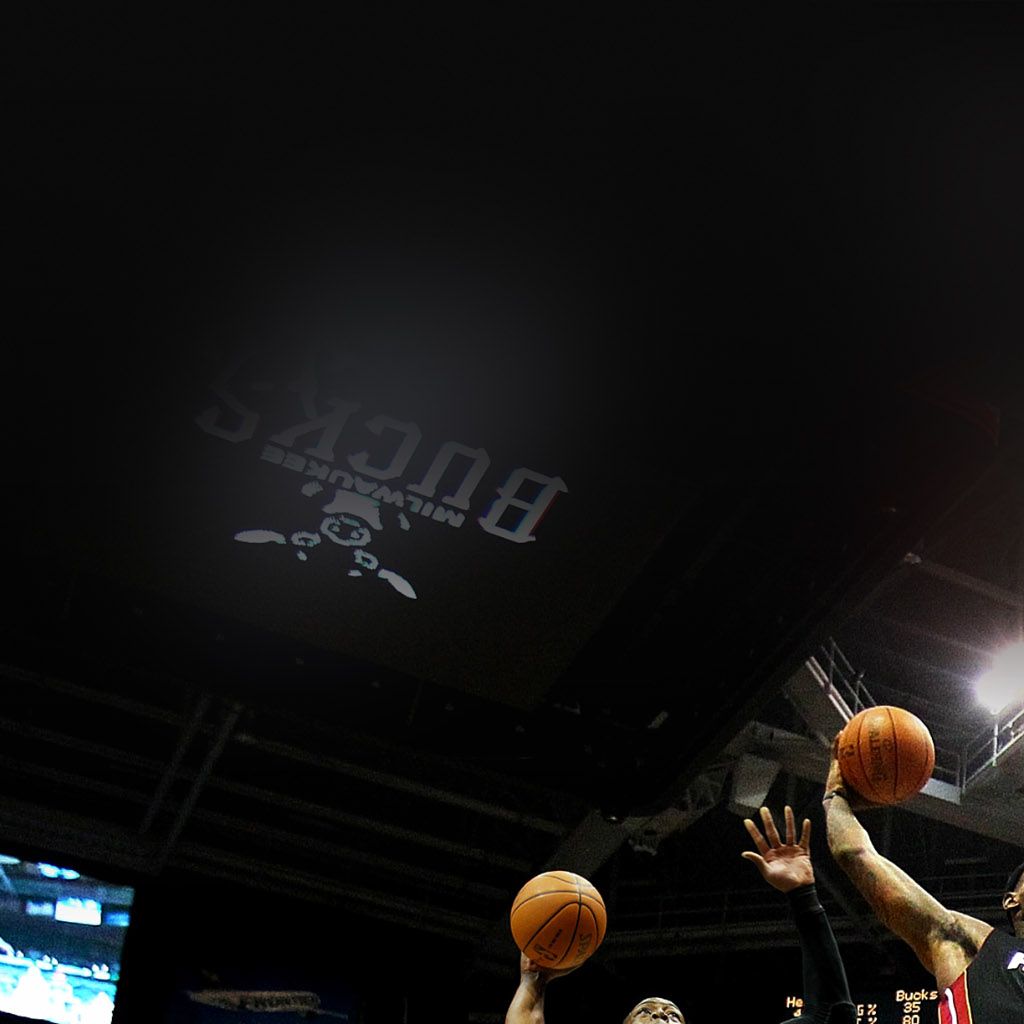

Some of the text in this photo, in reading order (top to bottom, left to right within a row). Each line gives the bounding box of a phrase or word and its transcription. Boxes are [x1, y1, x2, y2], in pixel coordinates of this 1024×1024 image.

[260, 444, 466, 528] MILWAUKEE
[785, 988, 938, 1008] He Bucks
[903, 1001, 921, 1014] 35
